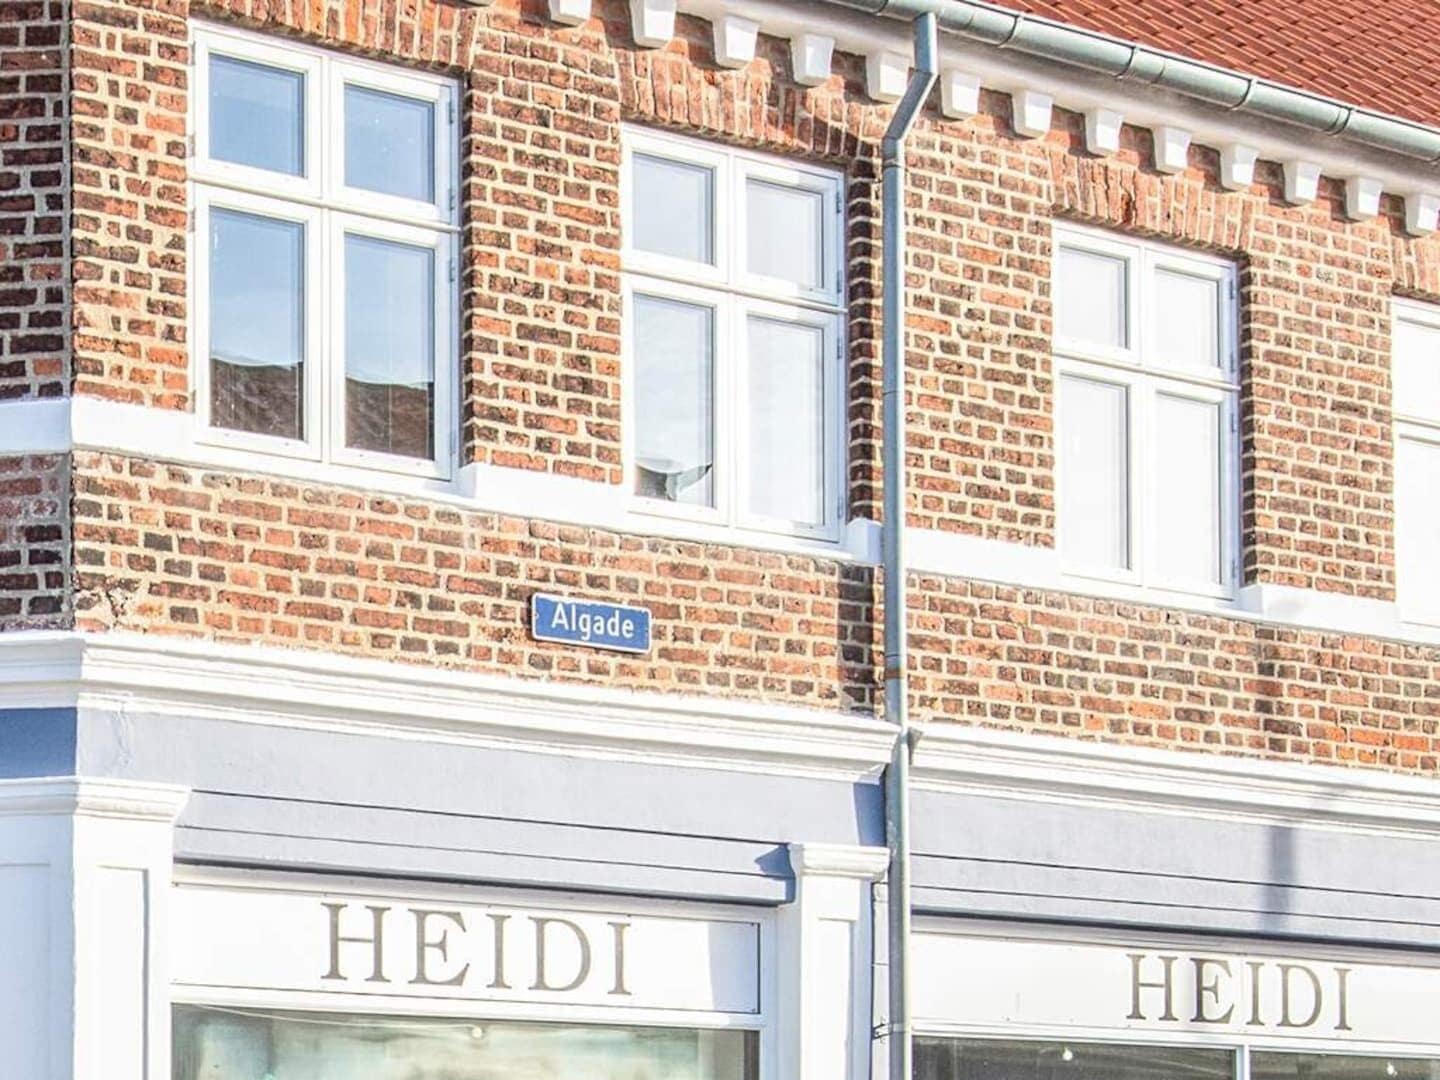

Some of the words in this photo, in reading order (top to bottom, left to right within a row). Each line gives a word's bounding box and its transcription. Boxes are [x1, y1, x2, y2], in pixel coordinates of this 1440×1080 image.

[551, 603, 635, 640] Algade
[320, 902, 632, 996] HEIDI
[1126, 953, 1353, 1031] HEIDI
